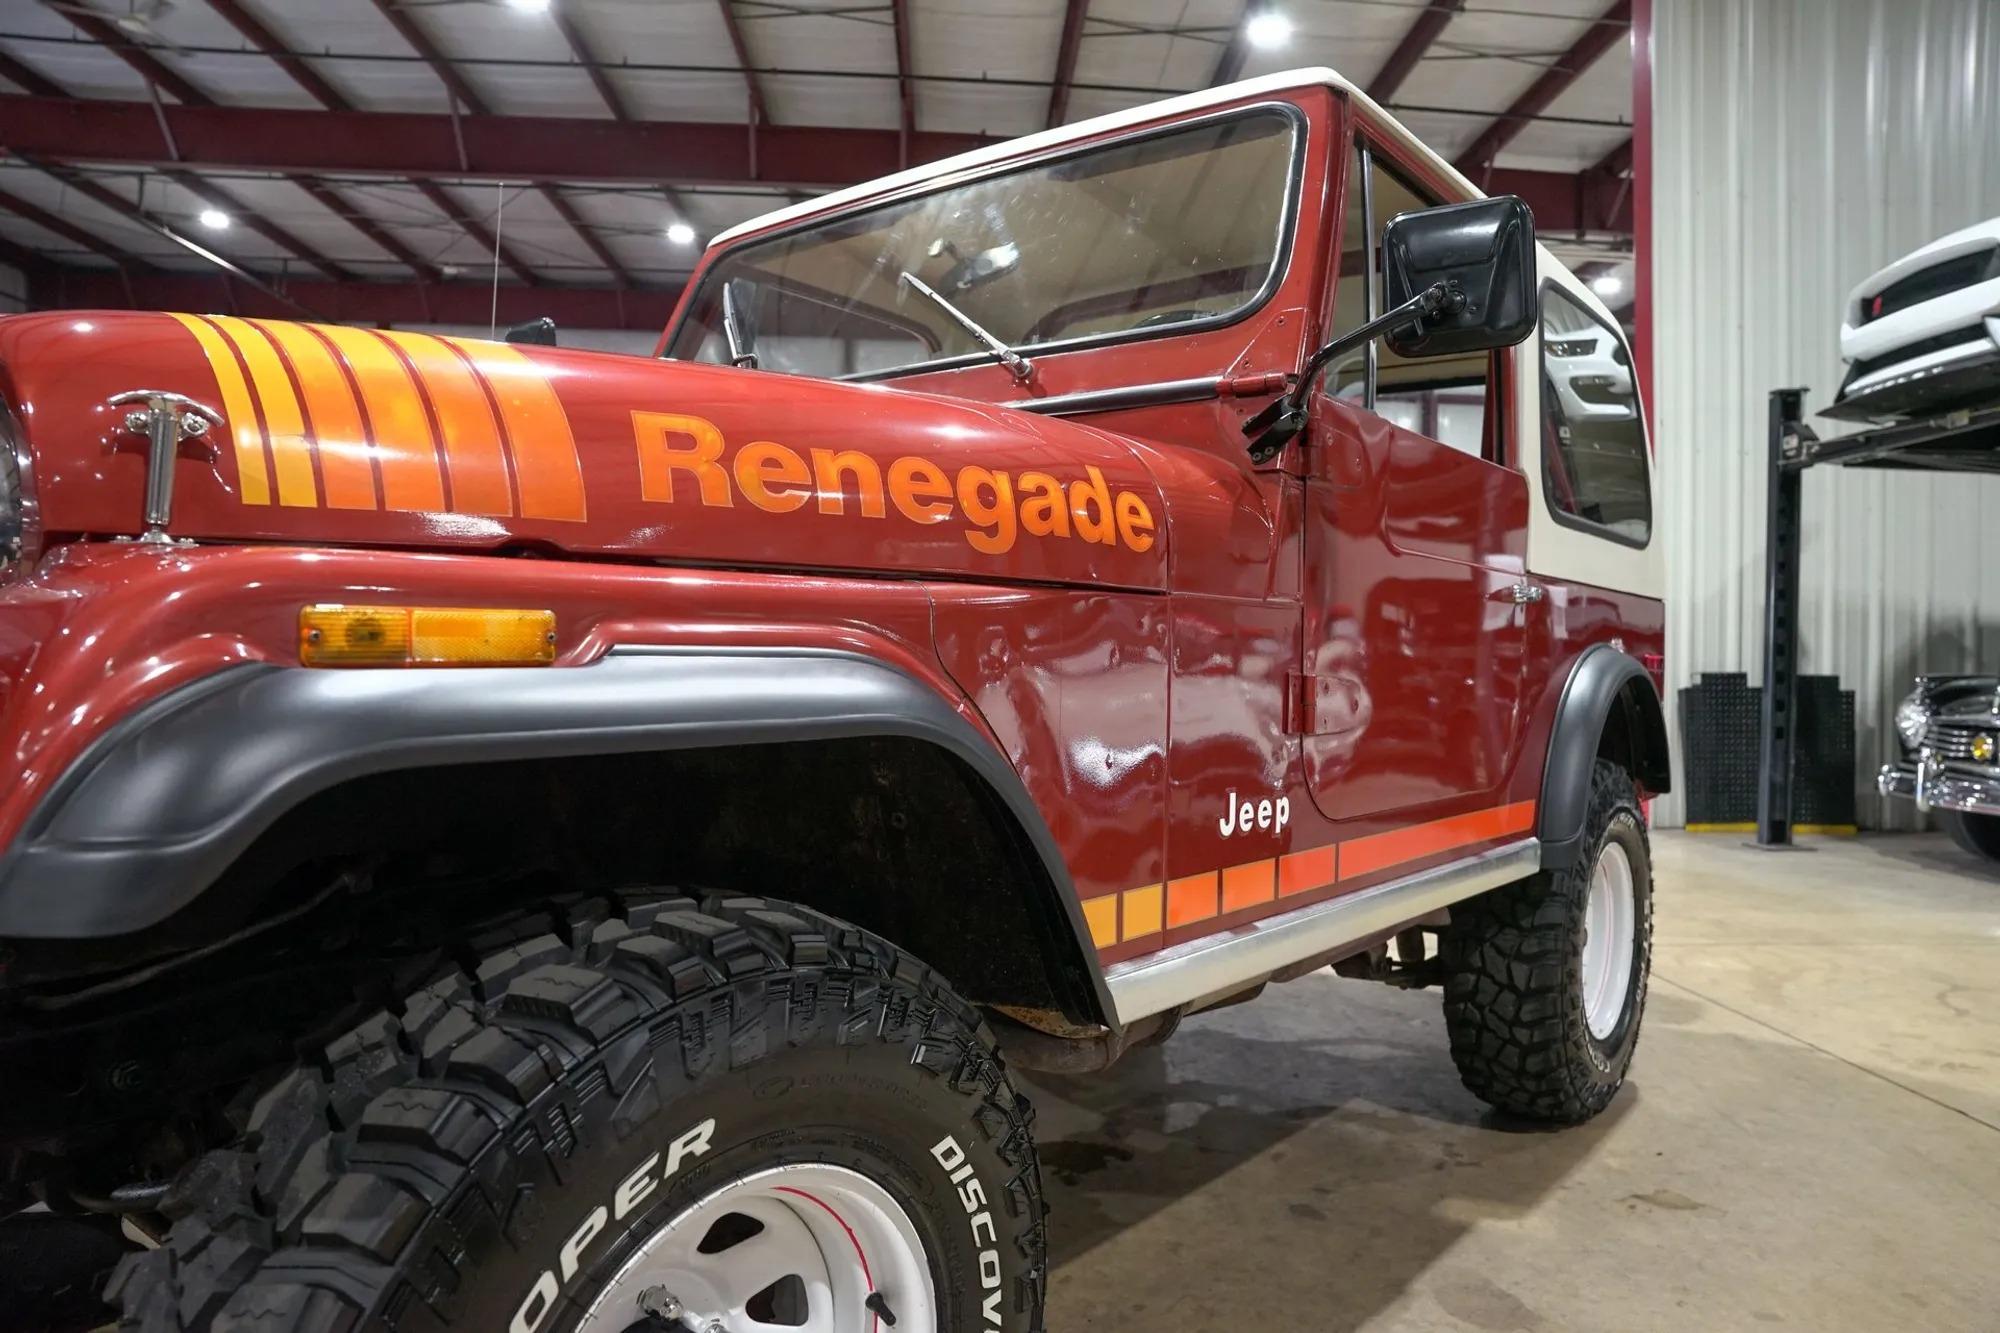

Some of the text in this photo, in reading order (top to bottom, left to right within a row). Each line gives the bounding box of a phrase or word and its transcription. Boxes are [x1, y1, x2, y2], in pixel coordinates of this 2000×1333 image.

[630, 410, 1155, 554] Renegade
[1219, 792, 1290, 837] Jeep
[509, 1118, 716, 1333] OPER
[930, 1135, 1002, 1333] DISCOV
